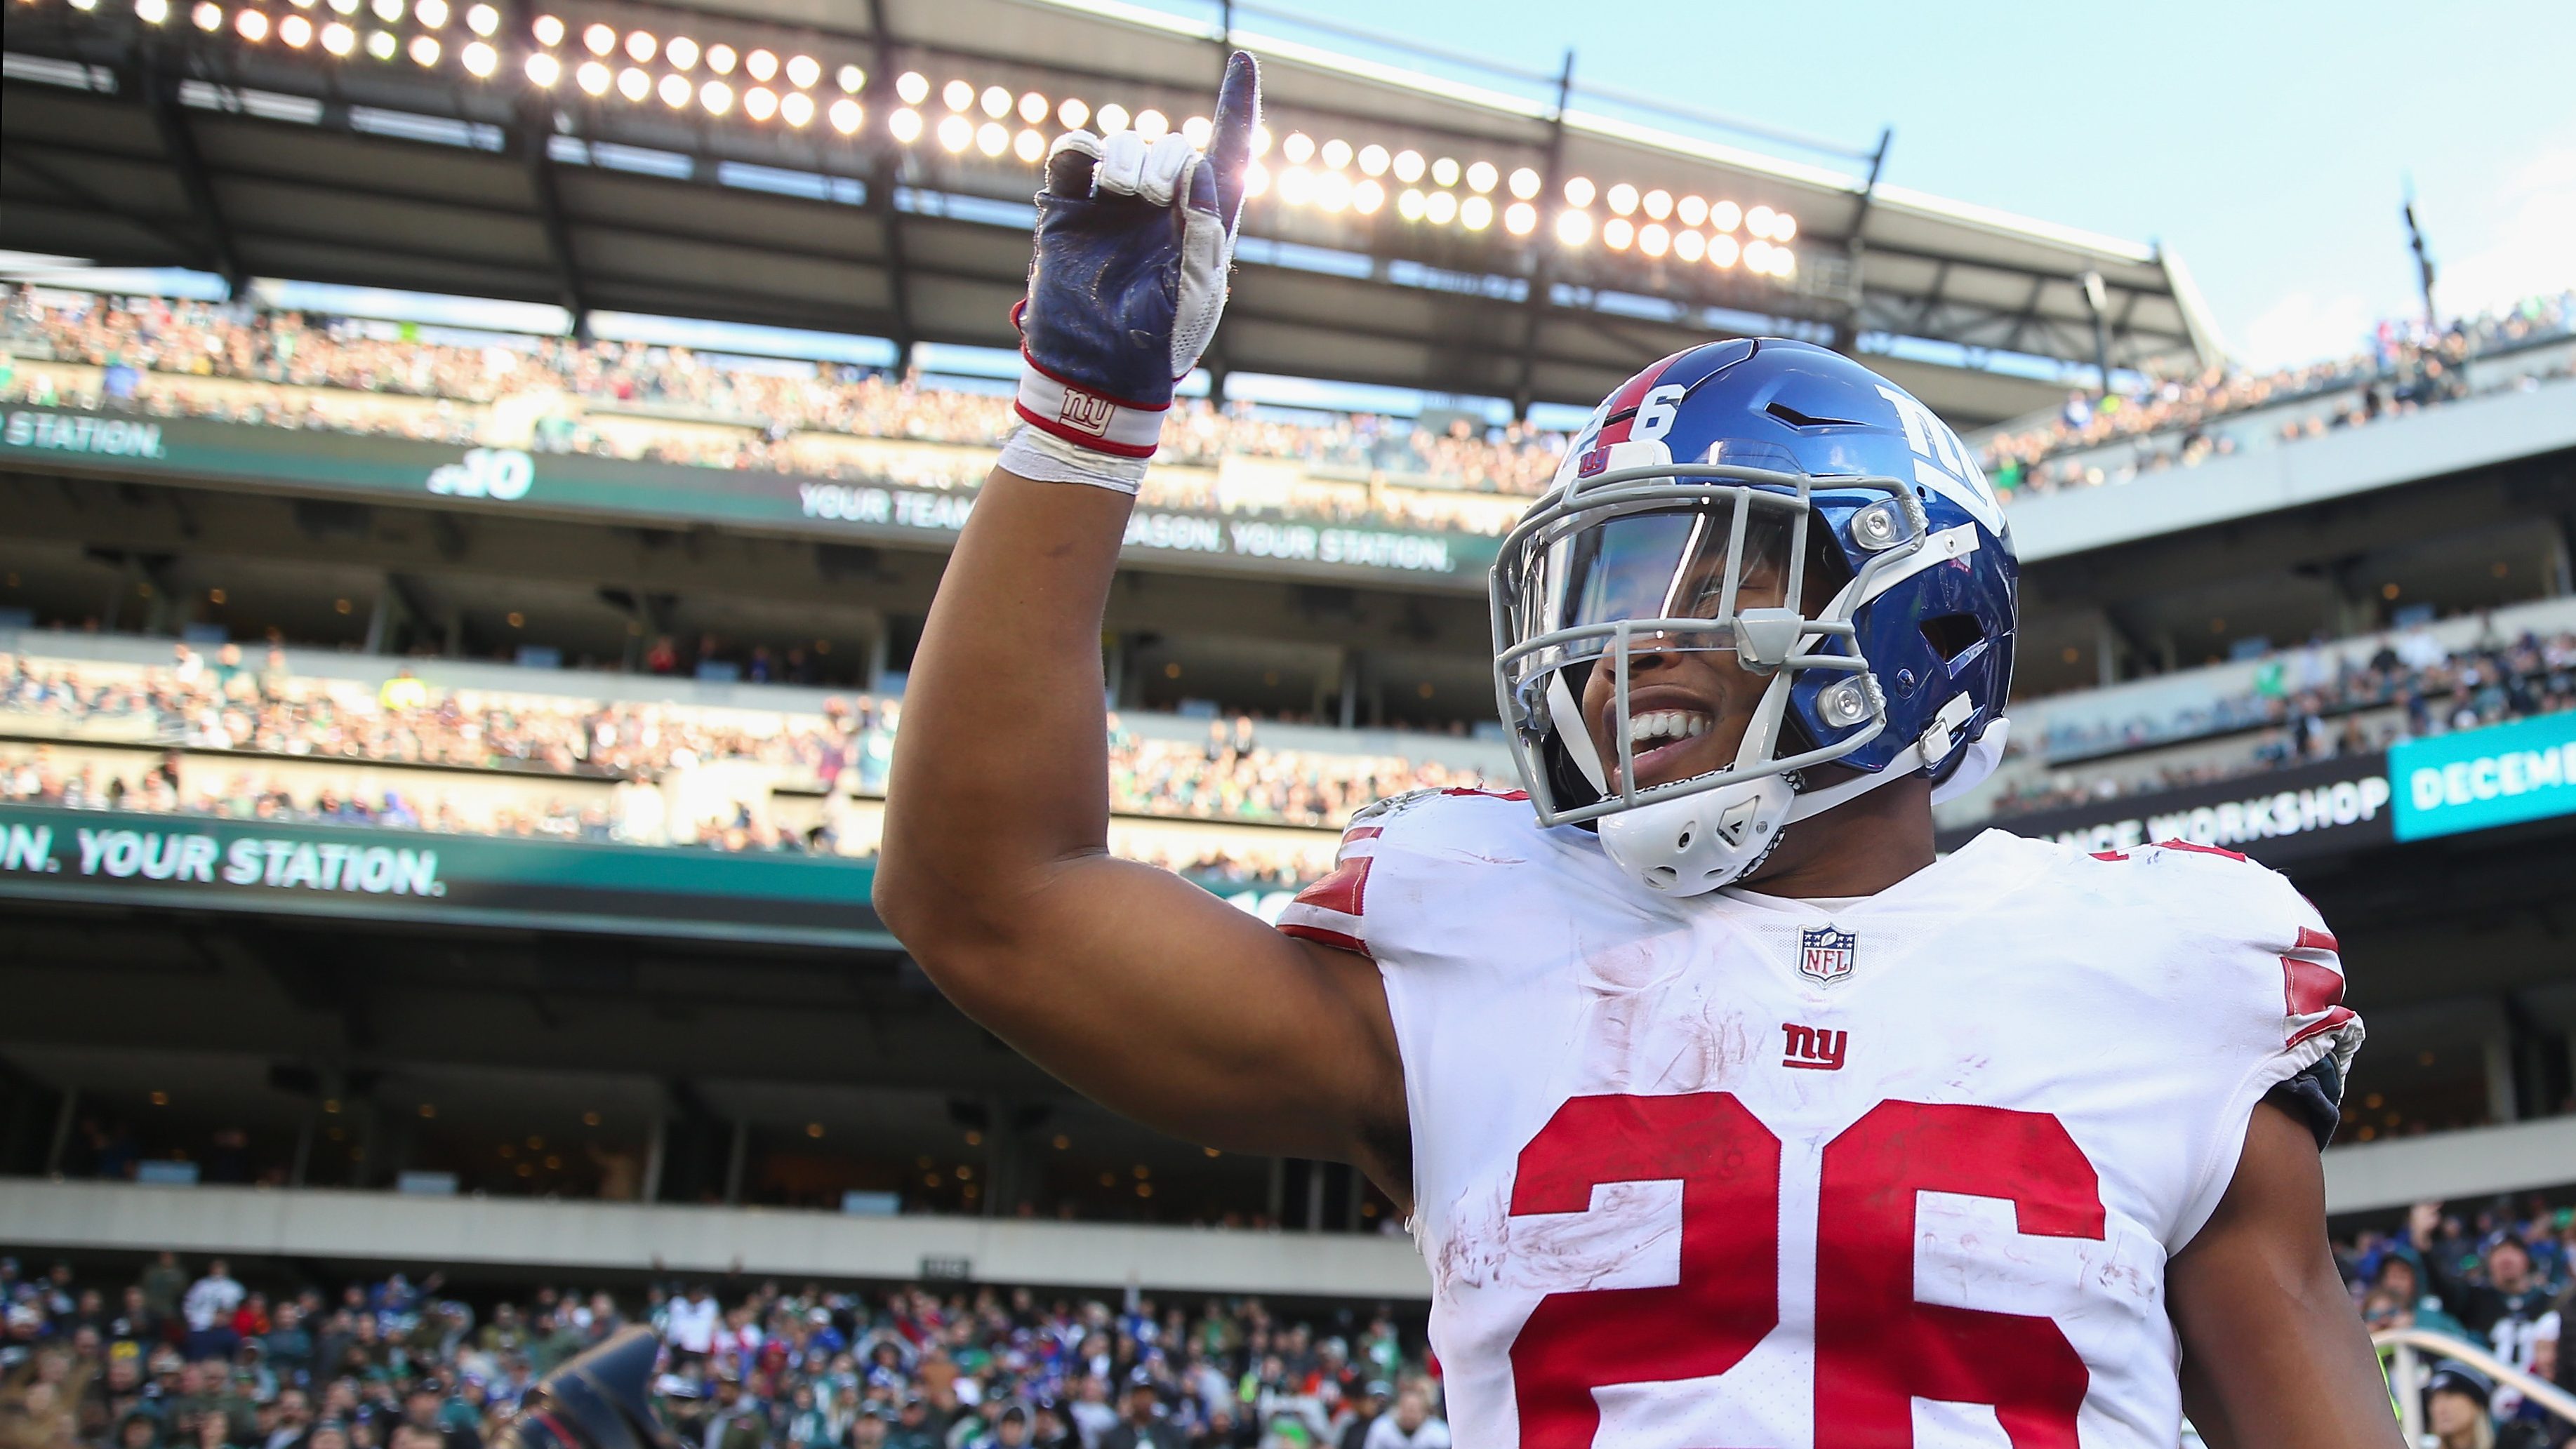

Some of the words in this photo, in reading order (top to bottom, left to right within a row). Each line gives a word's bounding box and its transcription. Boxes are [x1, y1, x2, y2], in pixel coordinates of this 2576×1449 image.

[4, 410, 167, 460] STATION.
[799, 482, 891, 525] YOUR
[1229, 519, 1317, 561] YOUR
[1318, 528, 1456, 573] STATION.
[2146, 775, 2390, 846] WORKSHOP
[77, 827, 220, 883] YOUR
[223, 837, 447, 897] STATION.
[1805, 949, 1849, 975] NFL
[1509, 1092, 2105, 1449] 26
